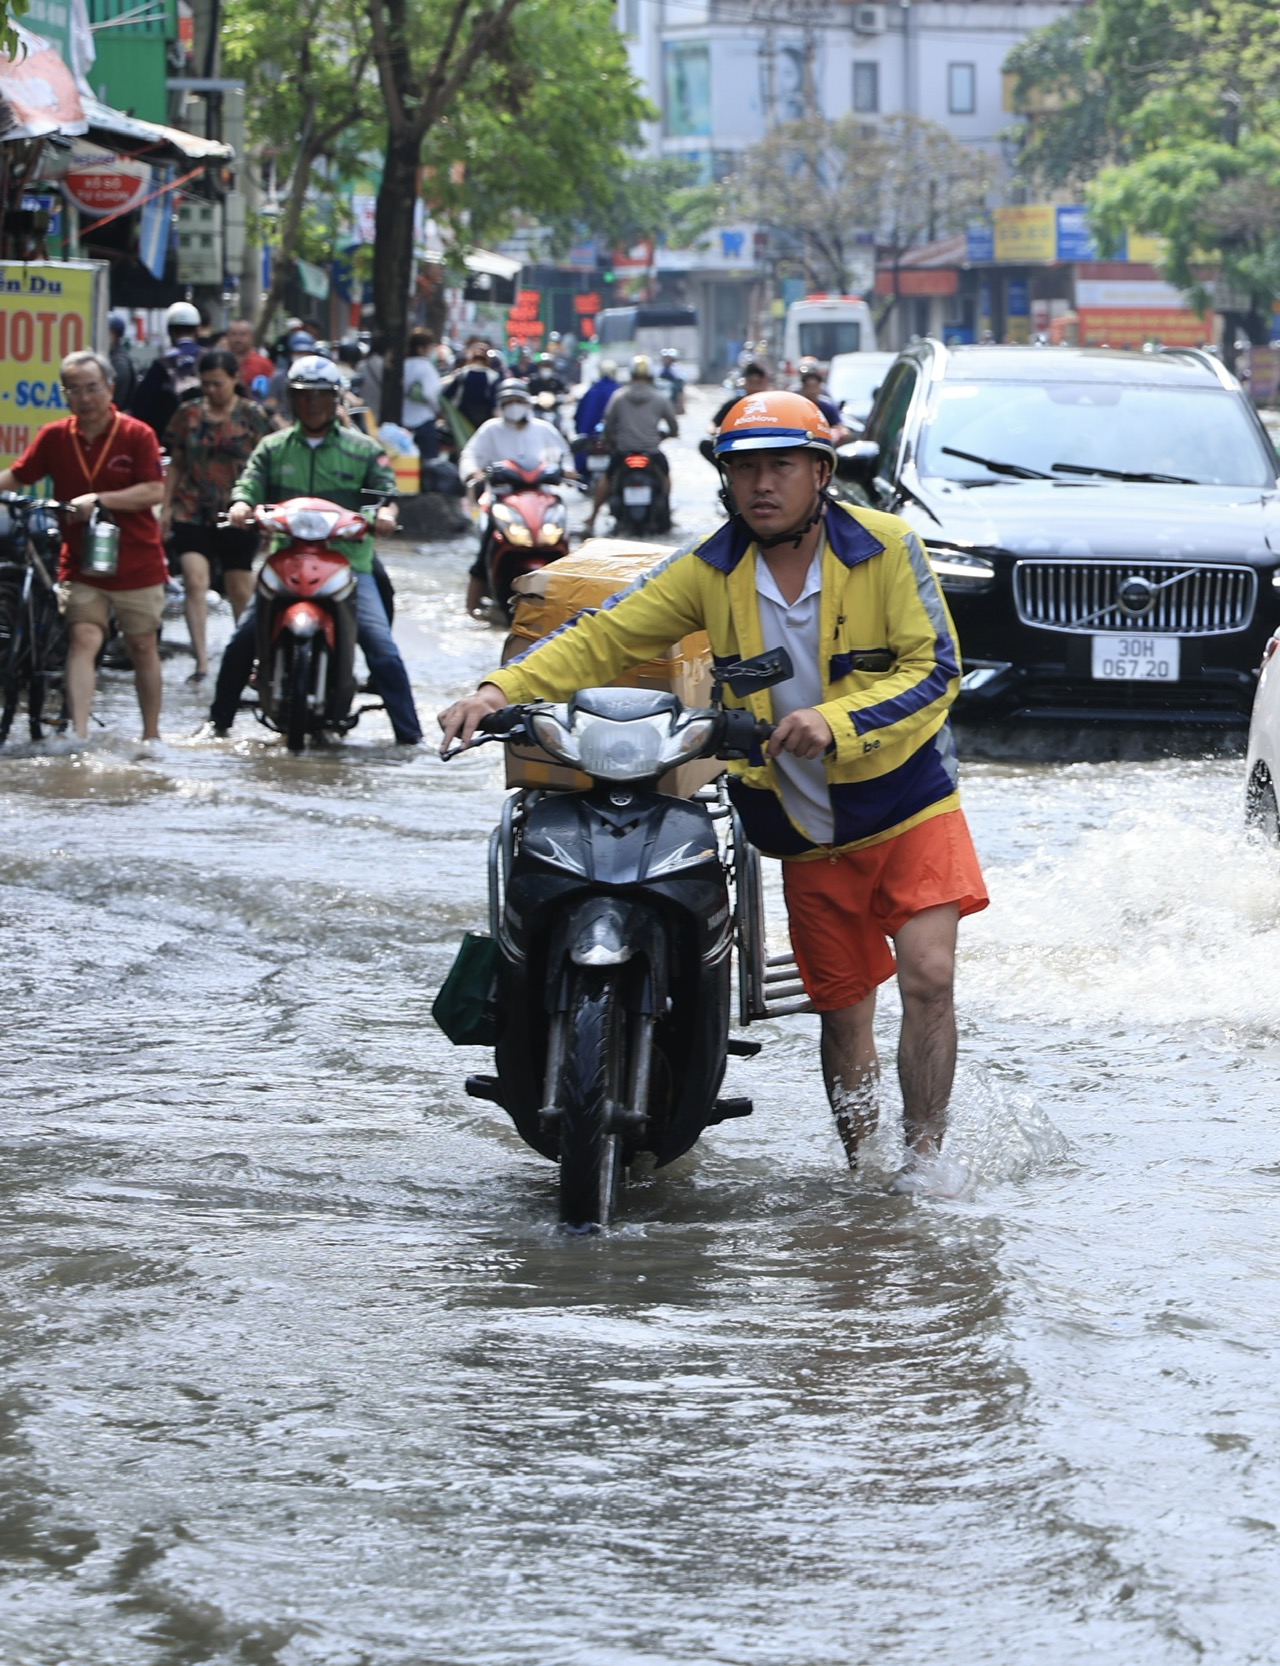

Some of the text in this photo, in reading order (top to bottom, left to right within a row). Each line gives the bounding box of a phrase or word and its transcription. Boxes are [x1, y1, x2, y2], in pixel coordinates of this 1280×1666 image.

[29, 275, 62, 295] Du
[0, 309, 84, 363] OTO
[15, 380, 70, 409] SCA
[1118, 639, 1155, 657] 30H
[1102, 659, 1169, 678] 067.20
[863, 739, 880, 754] be
